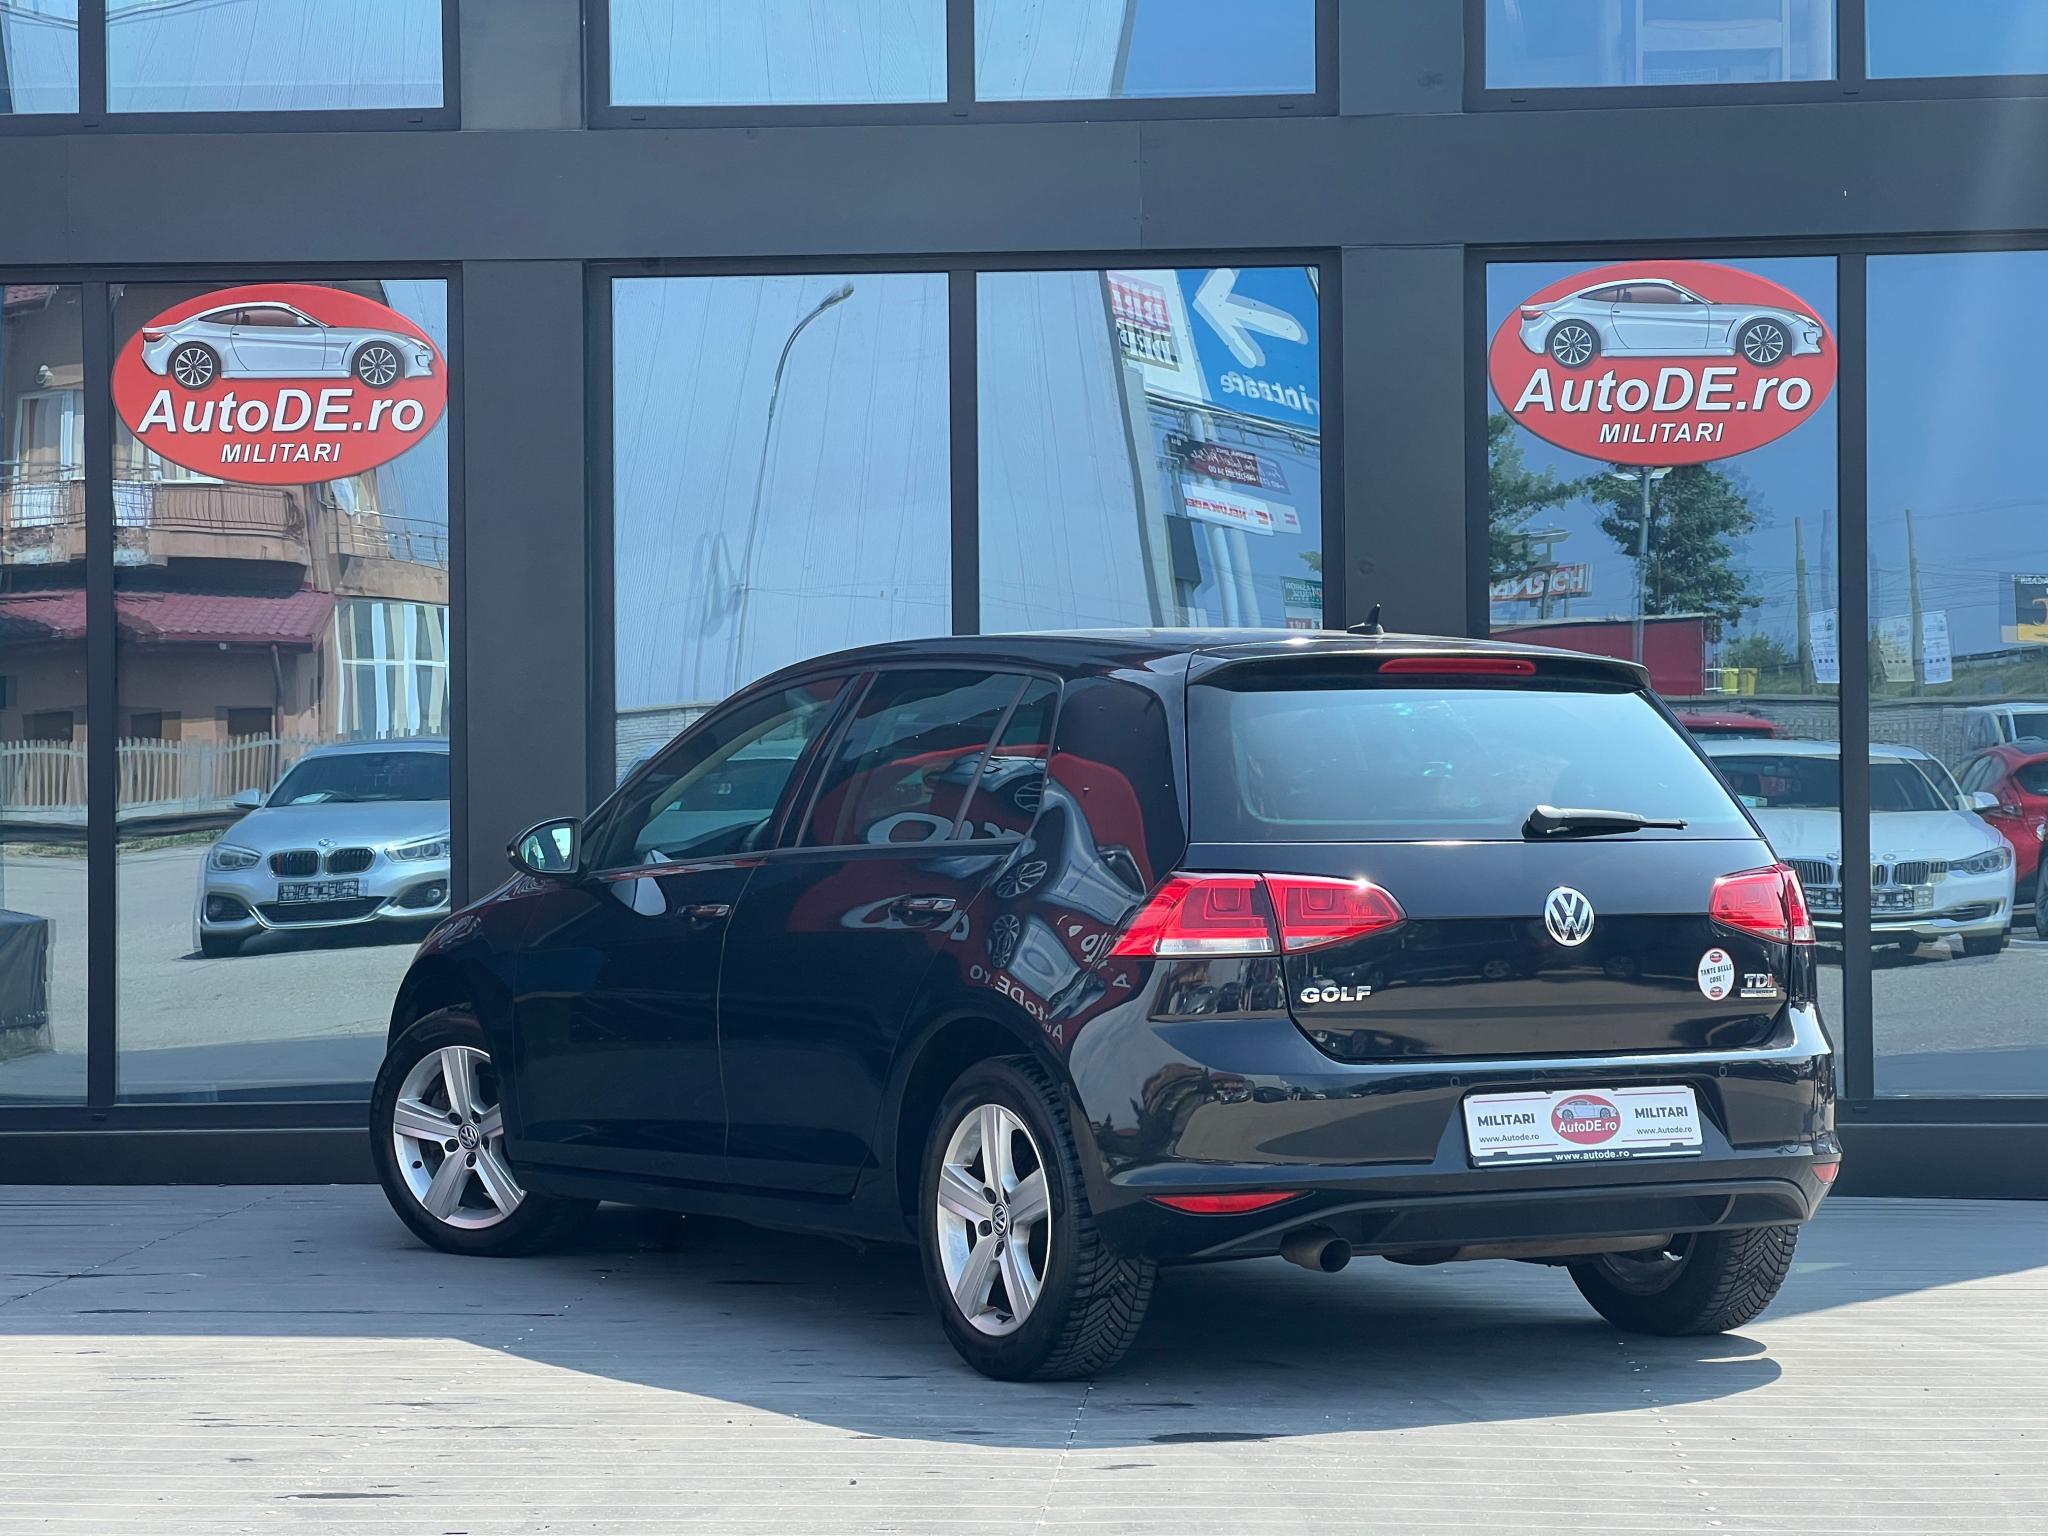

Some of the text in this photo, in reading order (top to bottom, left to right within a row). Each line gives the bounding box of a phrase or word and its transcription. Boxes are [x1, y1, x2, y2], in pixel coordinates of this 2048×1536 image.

[1514, 365, 1813, 414] AutoDE.ro
[136, 388, 425, 434] AutoDE.ro
[1598, 421, 1724, 443] MILITARI
[219, 442, 341, 464] MILITARI
[1744, 973, 1773, 988] TDI
[1300, 985, 1372, 1004] GOLF
[1477, 1106, 1689, 1133] MILITARI AutoDE.ro MILITARI
[1479, 1125, 1693, 1143] www.Autode.ro www.Autode.ro
[1554, 1150, 1630, 1161] www.autode.ro
